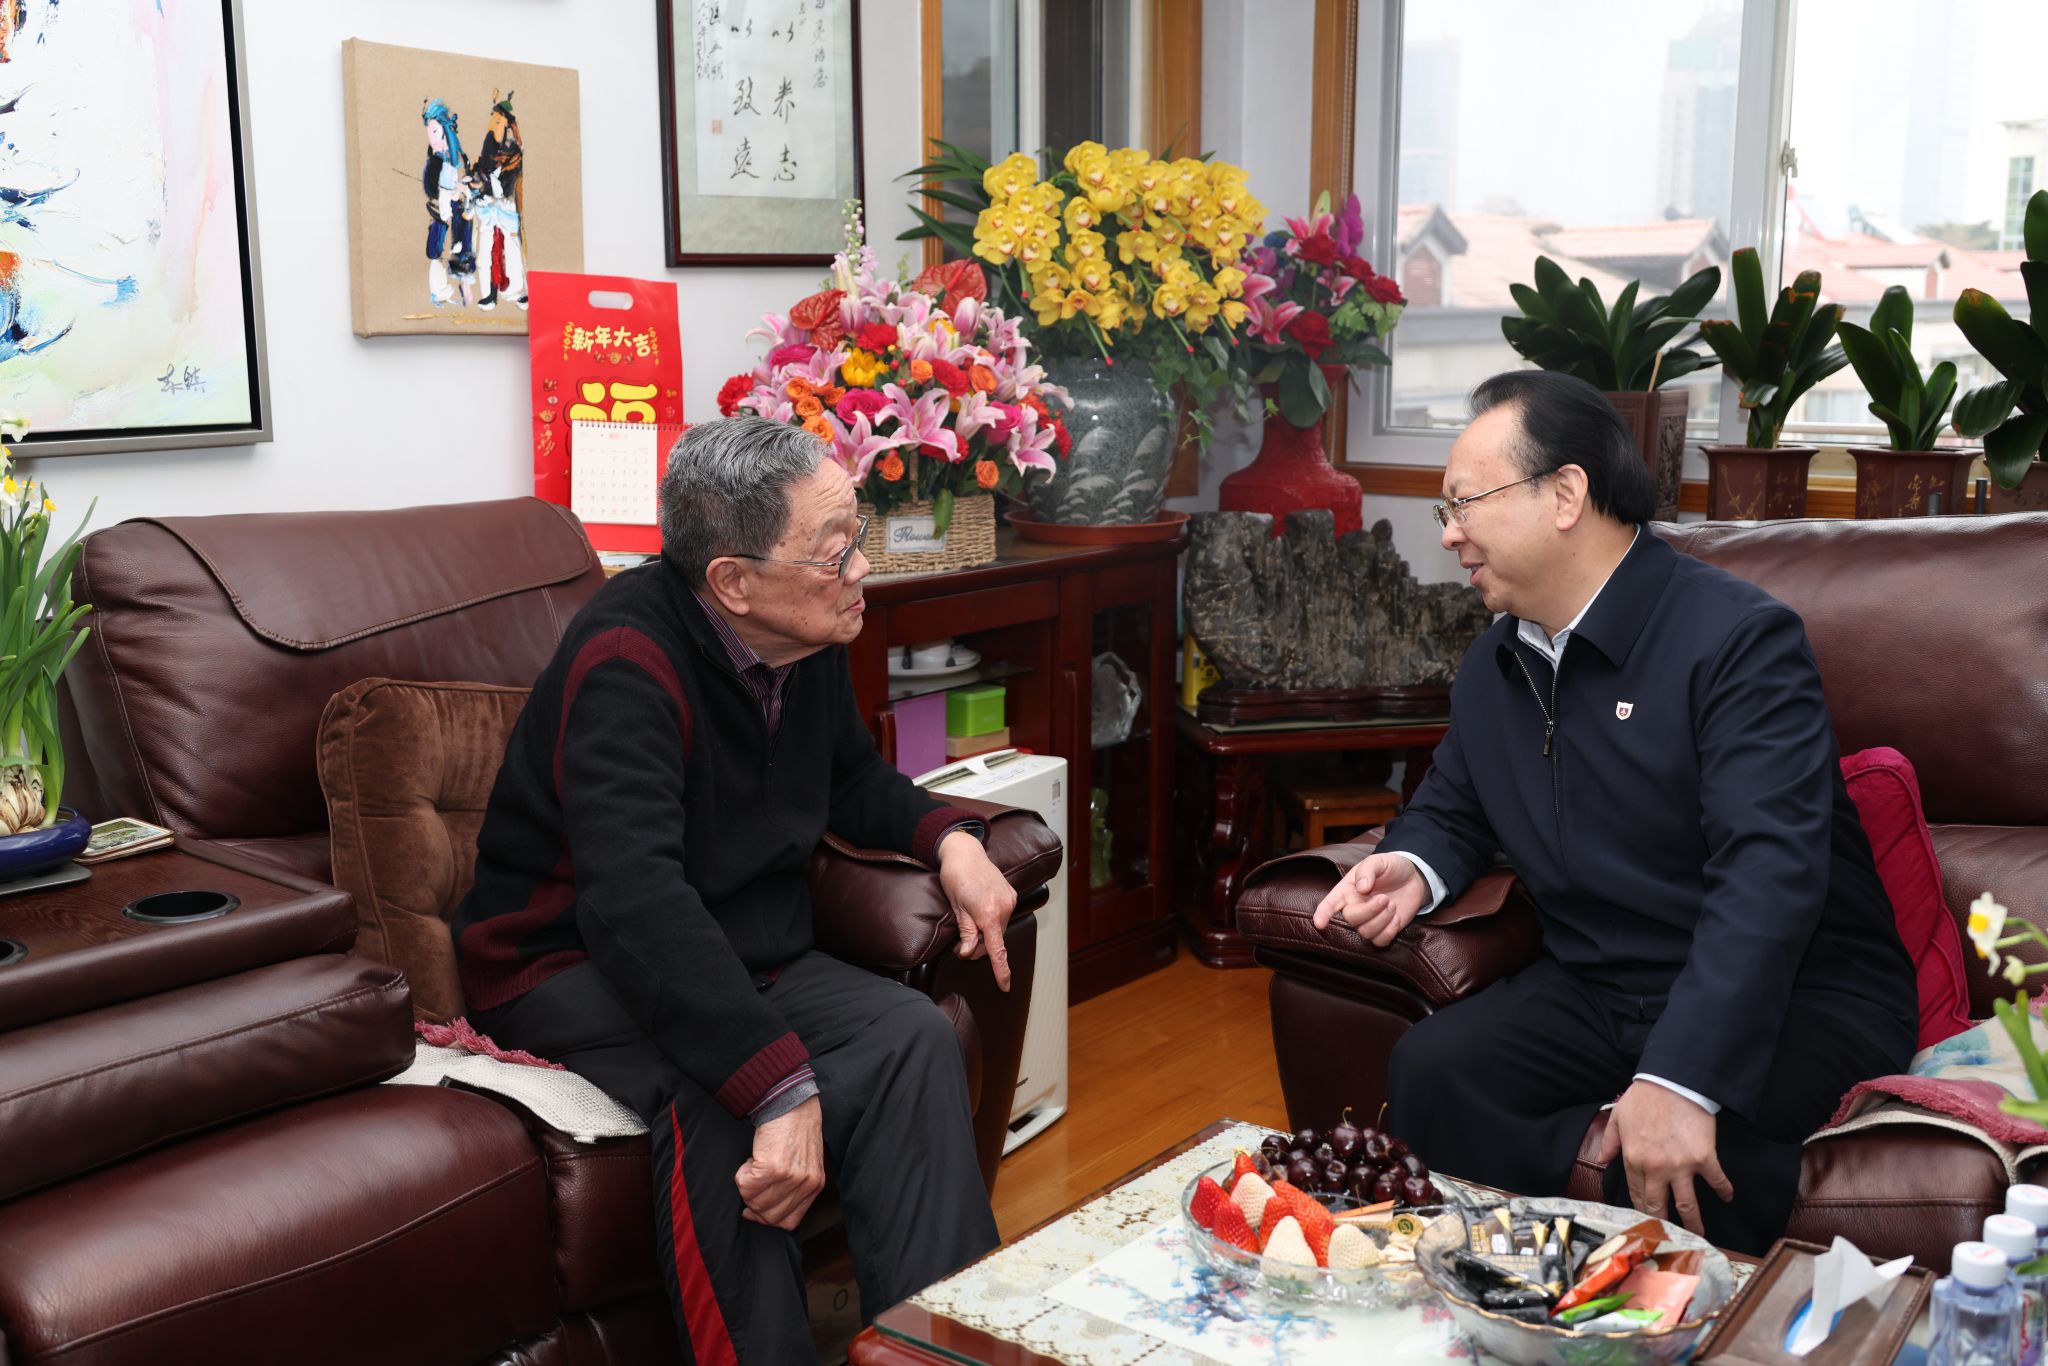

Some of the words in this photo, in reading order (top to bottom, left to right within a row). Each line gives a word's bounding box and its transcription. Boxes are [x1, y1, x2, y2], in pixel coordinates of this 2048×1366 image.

[571, 325, 651, 358] 新年大吉
[893, 525, 935, 543] Flowe
